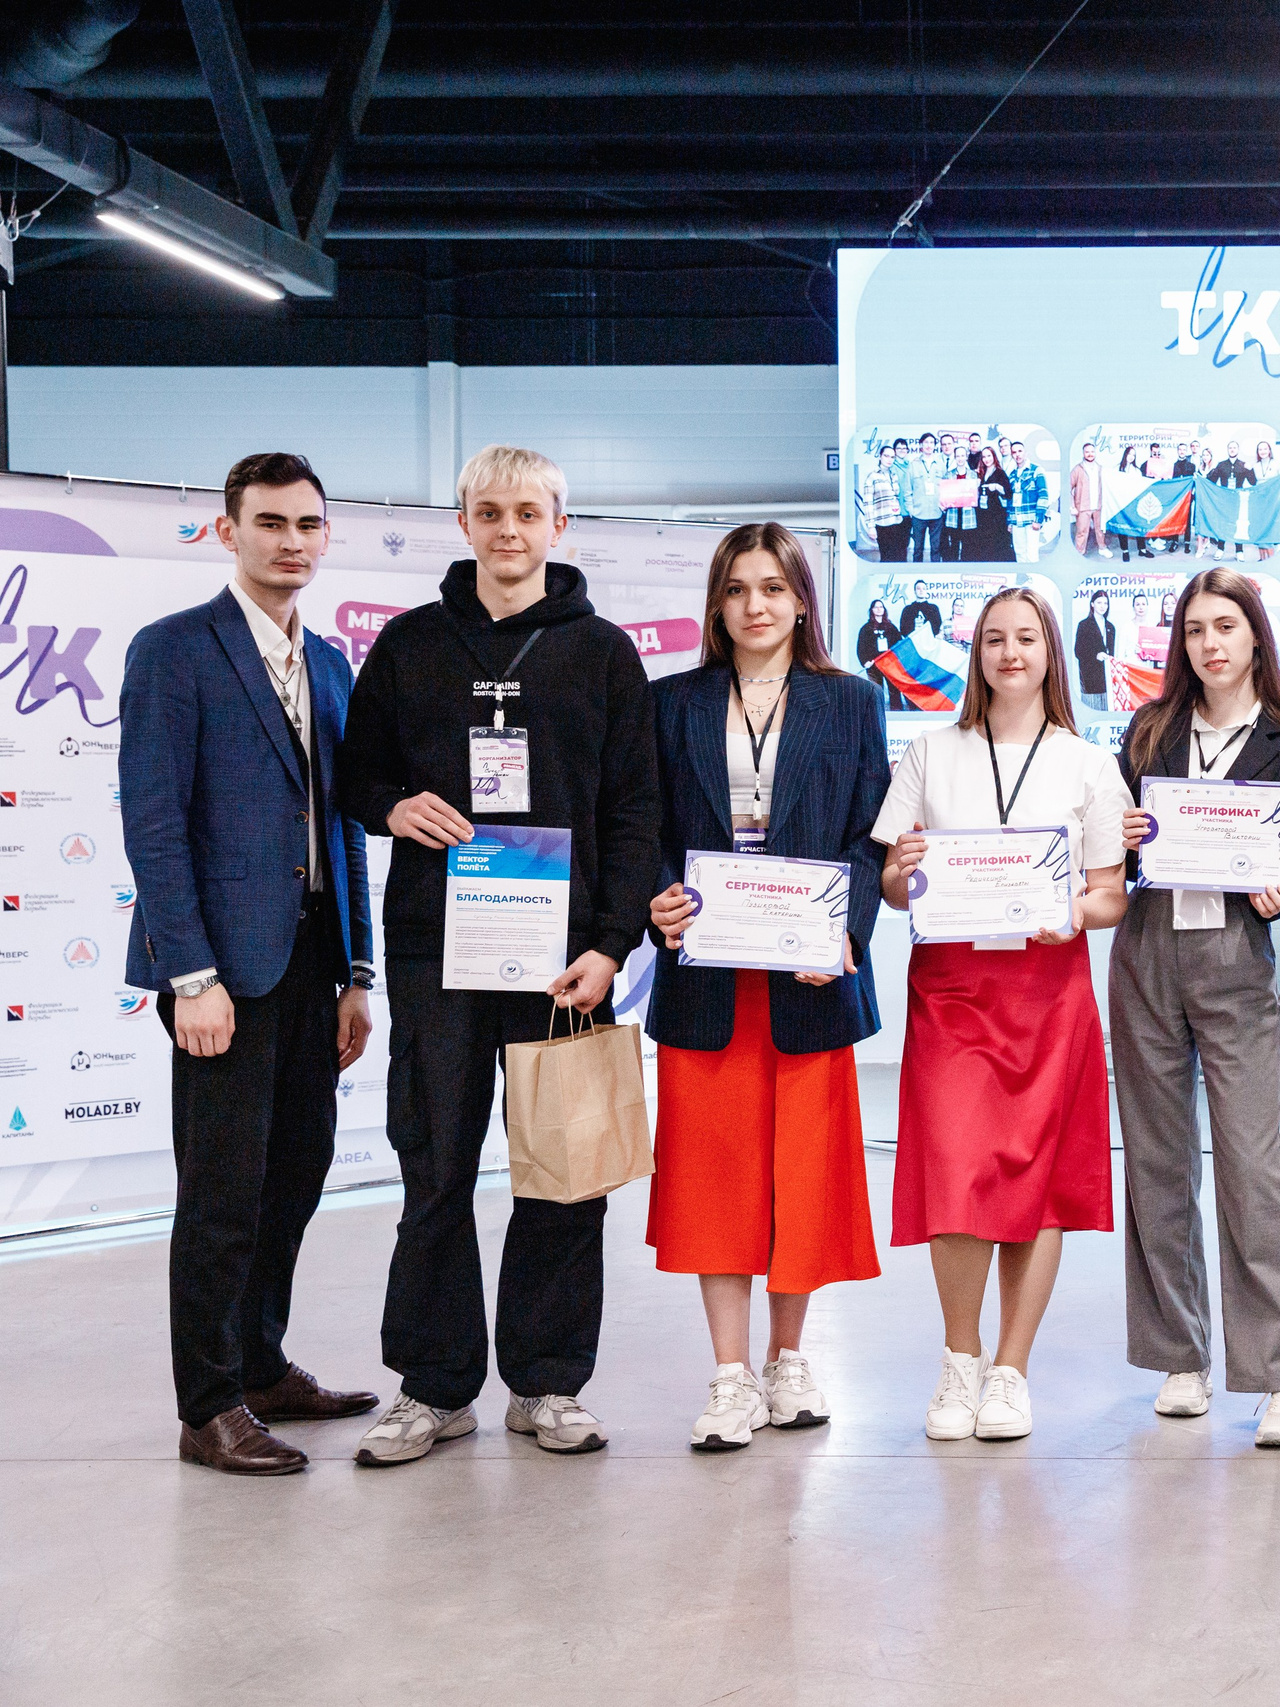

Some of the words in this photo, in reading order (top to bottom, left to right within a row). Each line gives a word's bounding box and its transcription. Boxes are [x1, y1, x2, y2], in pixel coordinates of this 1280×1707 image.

[1179, 806, 1260, 817] СЕРТИФИКАТ
[947, 855, 1032, 866] СЕРТИФИКАТ
[457, 863, 490, 871] ПОЛЁТА
[725, 881, 811, 896] СЕРТИФИКАТ
[456, 893, 552, 905] БЛАГОДАРНОСТЬ
[64, 1101, 141, 1120] MOLADZ.BY
